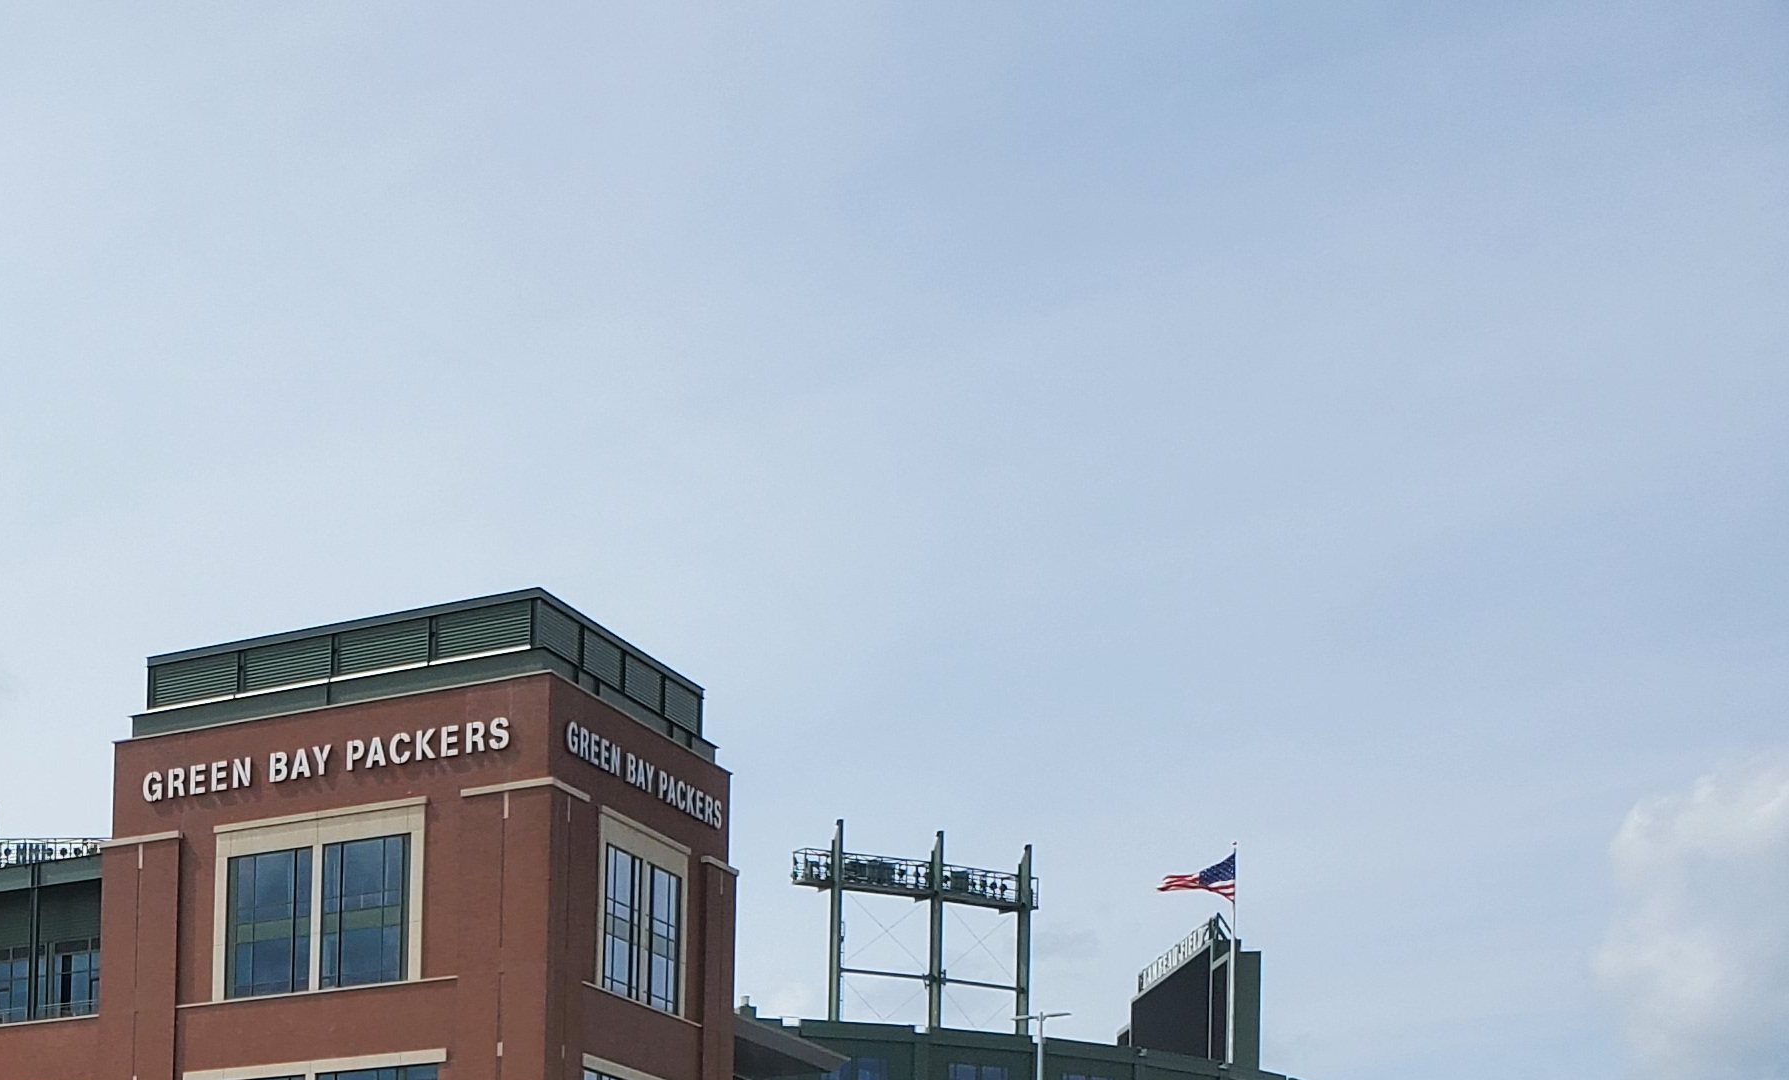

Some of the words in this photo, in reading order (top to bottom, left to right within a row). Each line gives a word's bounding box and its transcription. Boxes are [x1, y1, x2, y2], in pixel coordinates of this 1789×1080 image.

[142, 757, 252, 802] GREEN
[269, 744, 331, 784] BAY
[346, 717, 510, 771] PACKERS
[567, 721, 621, 777] GREEN
[625, 752, 655, 793] BAY
[658, 770, 722, 830] PACKERS
